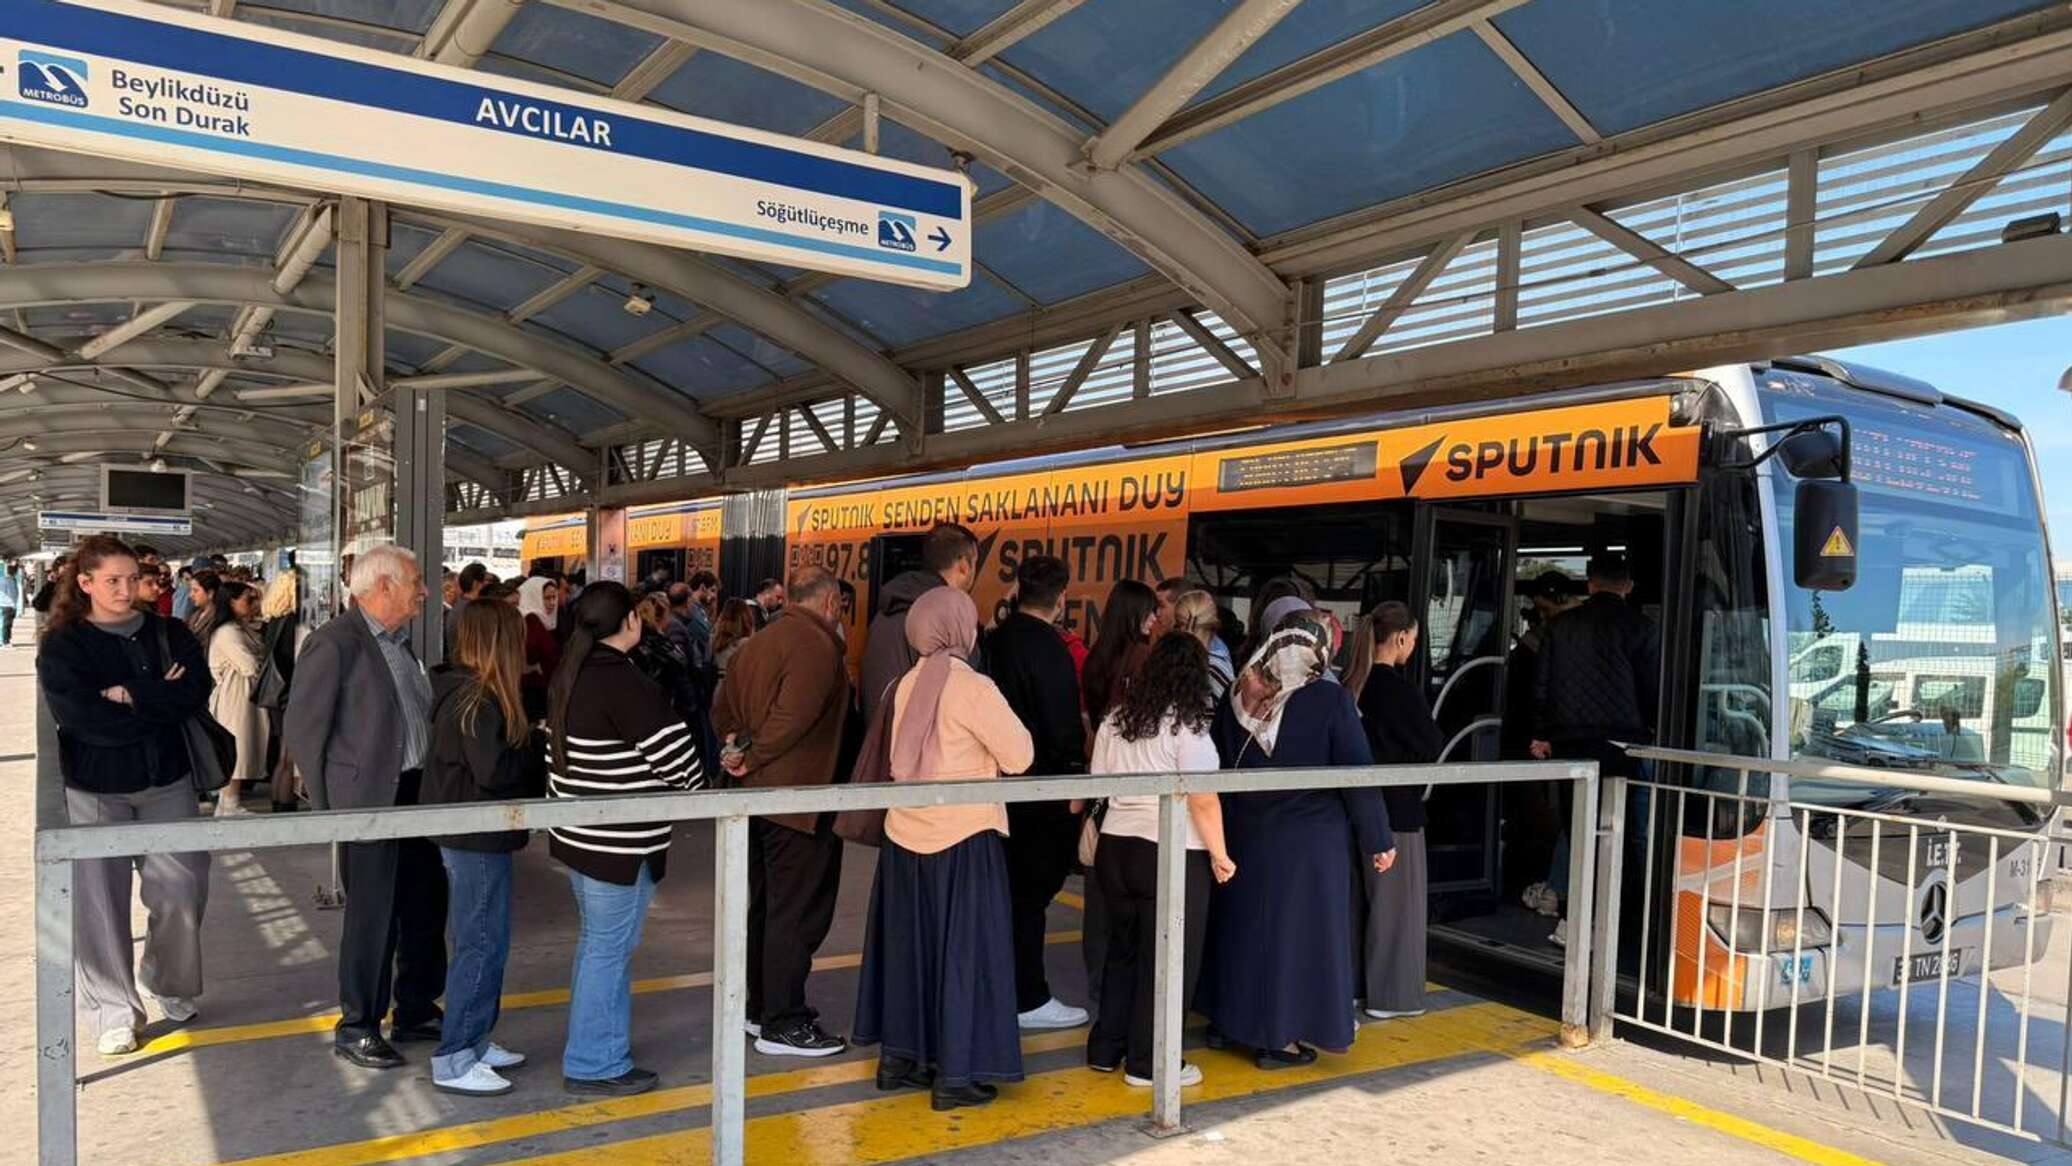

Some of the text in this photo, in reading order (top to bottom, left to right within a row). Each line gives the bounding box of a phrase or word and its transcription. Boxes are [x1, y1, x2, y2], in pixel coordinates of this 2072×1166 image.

[23, 87, 86, 106] METROBÜS
[111, 69, 250, 112] Beylikdüzü
[118, 97, 250, 136] Son Durak
[476, 98, 612, 146] AVCILAR
[757, 200, 870, 235] Söğütlüçeşme
[1446, 422, 1663, 481] SPUTNIK
[811, 470, 1186, 531] SPUTNIK SENDEN SAKLANANI DUY
[1916, 957, 1932, 977] TN
